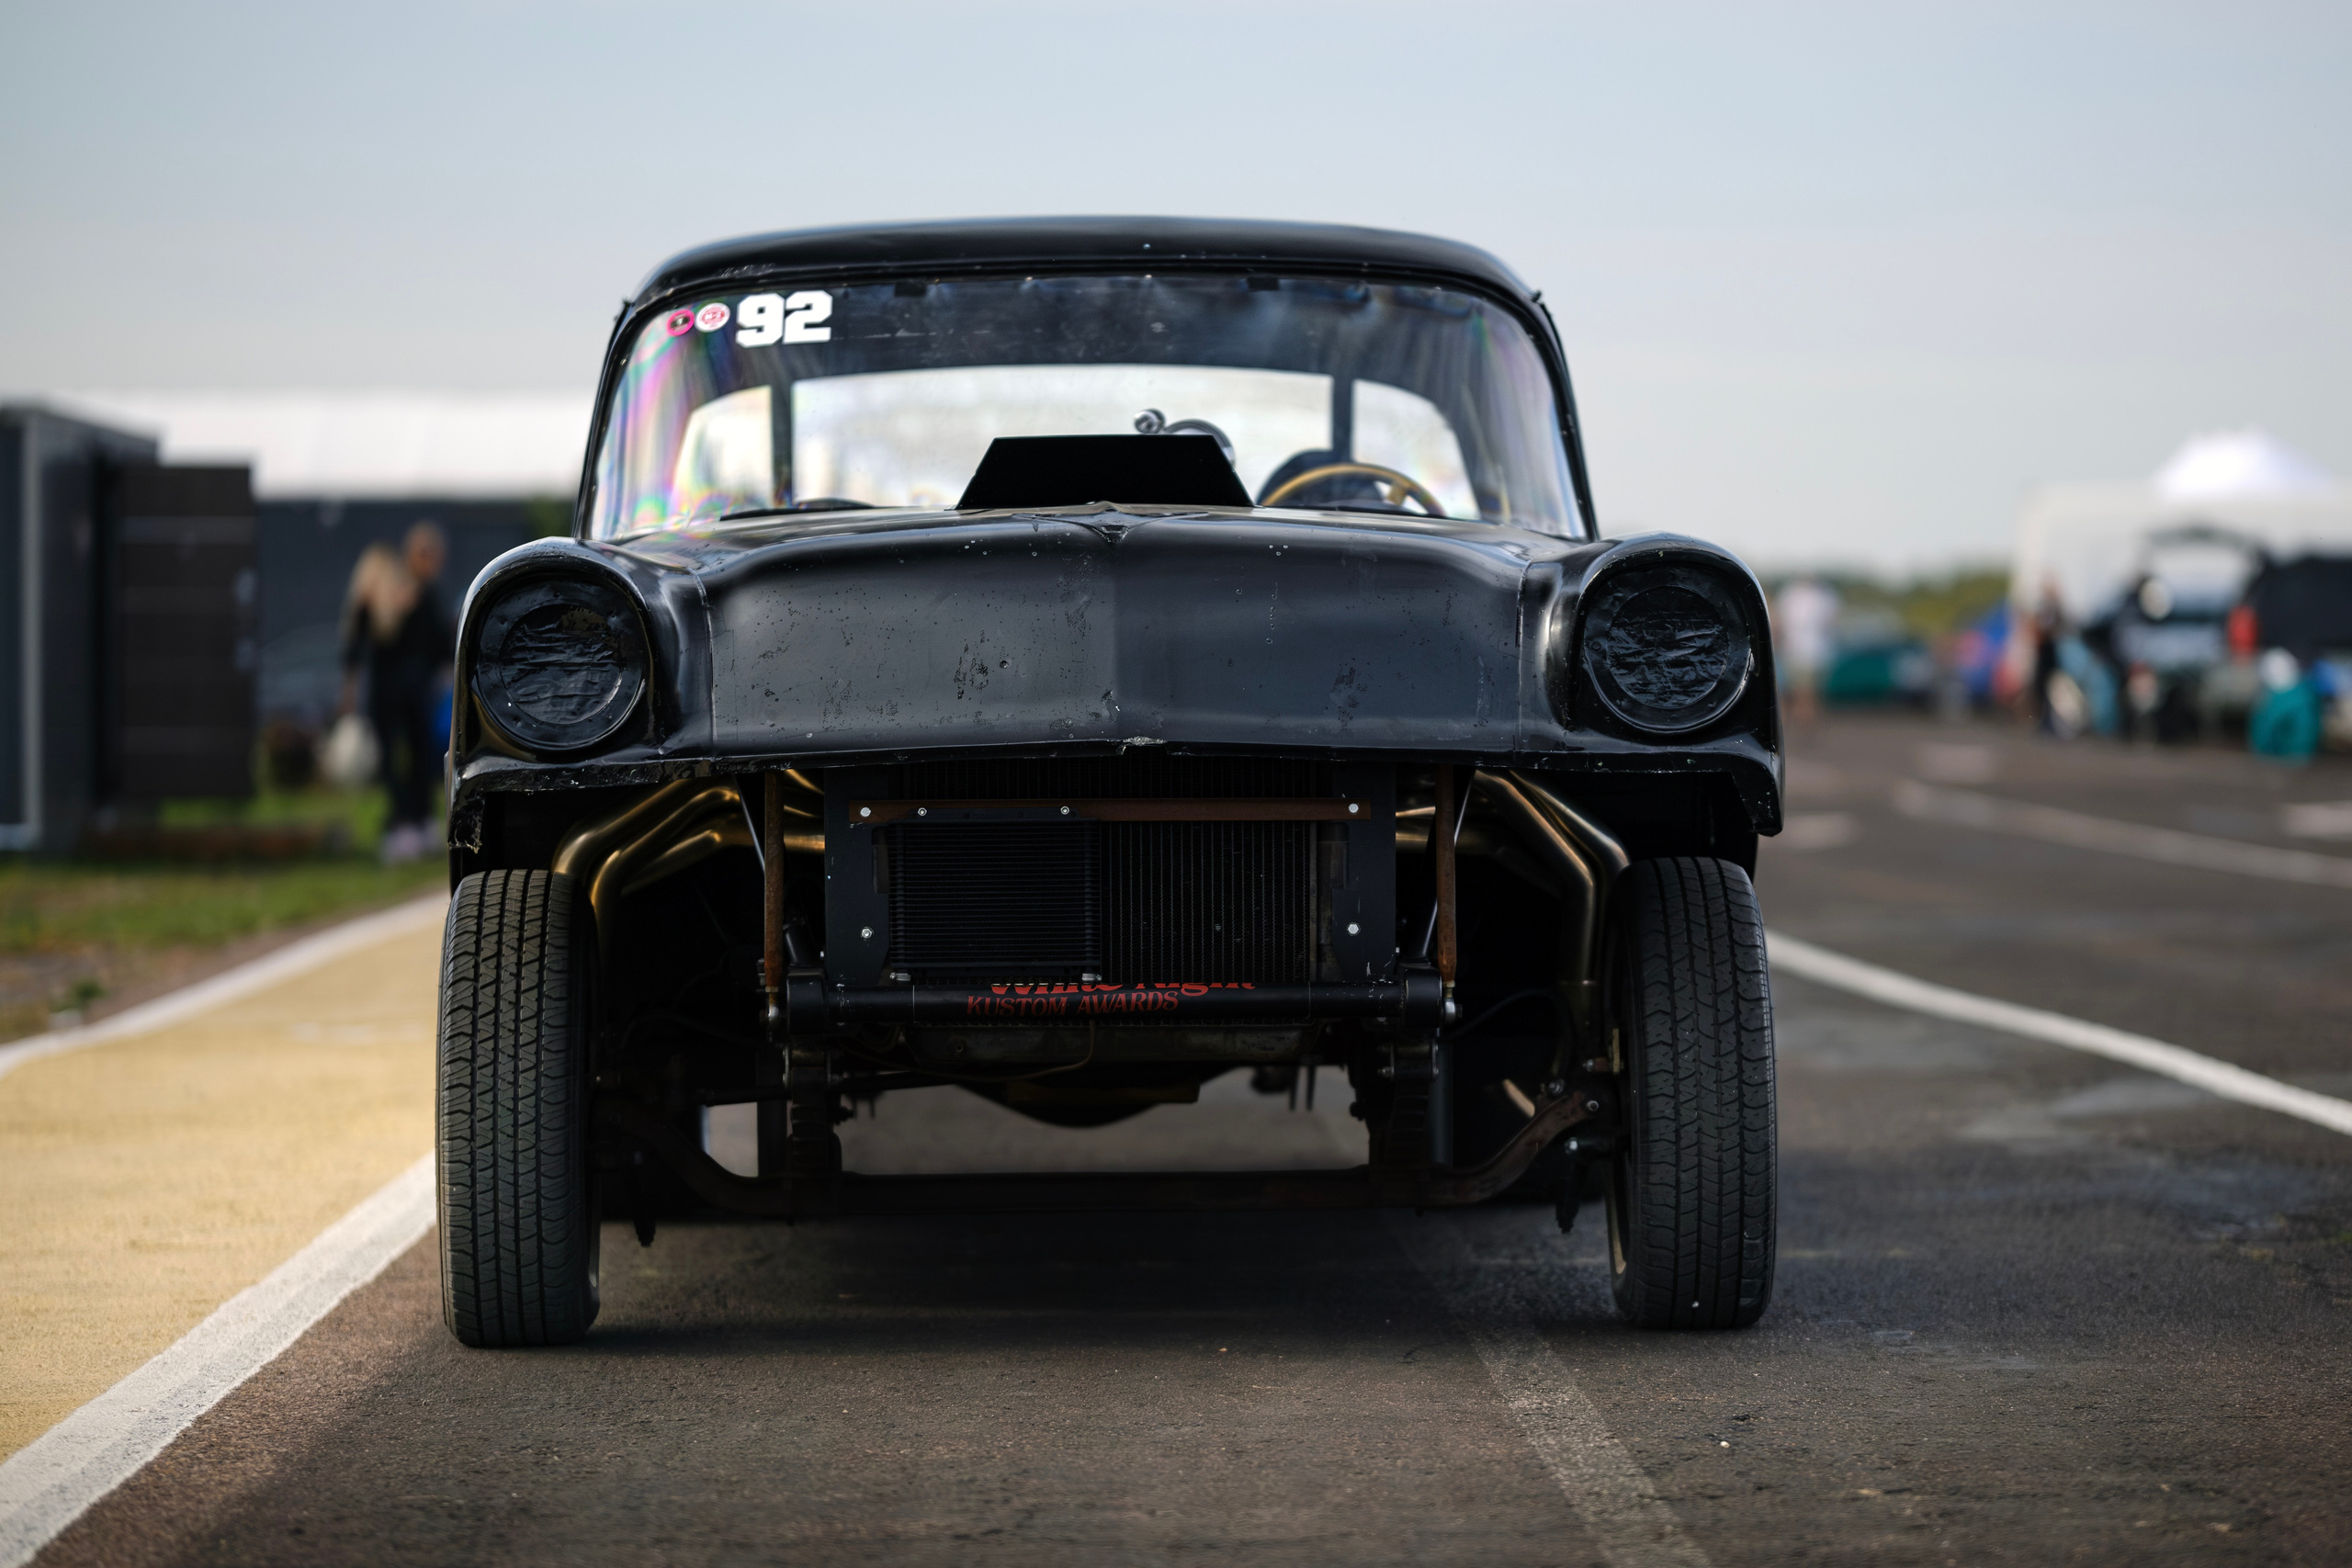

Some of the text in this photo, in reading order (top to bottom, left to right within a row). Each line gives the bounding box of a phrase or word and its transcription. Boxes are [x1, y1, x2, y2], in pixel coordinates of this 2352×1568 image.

[737, 290, 832, 347] 92
[967, 991, 1179, 1016] KUSTOM AWARDS
